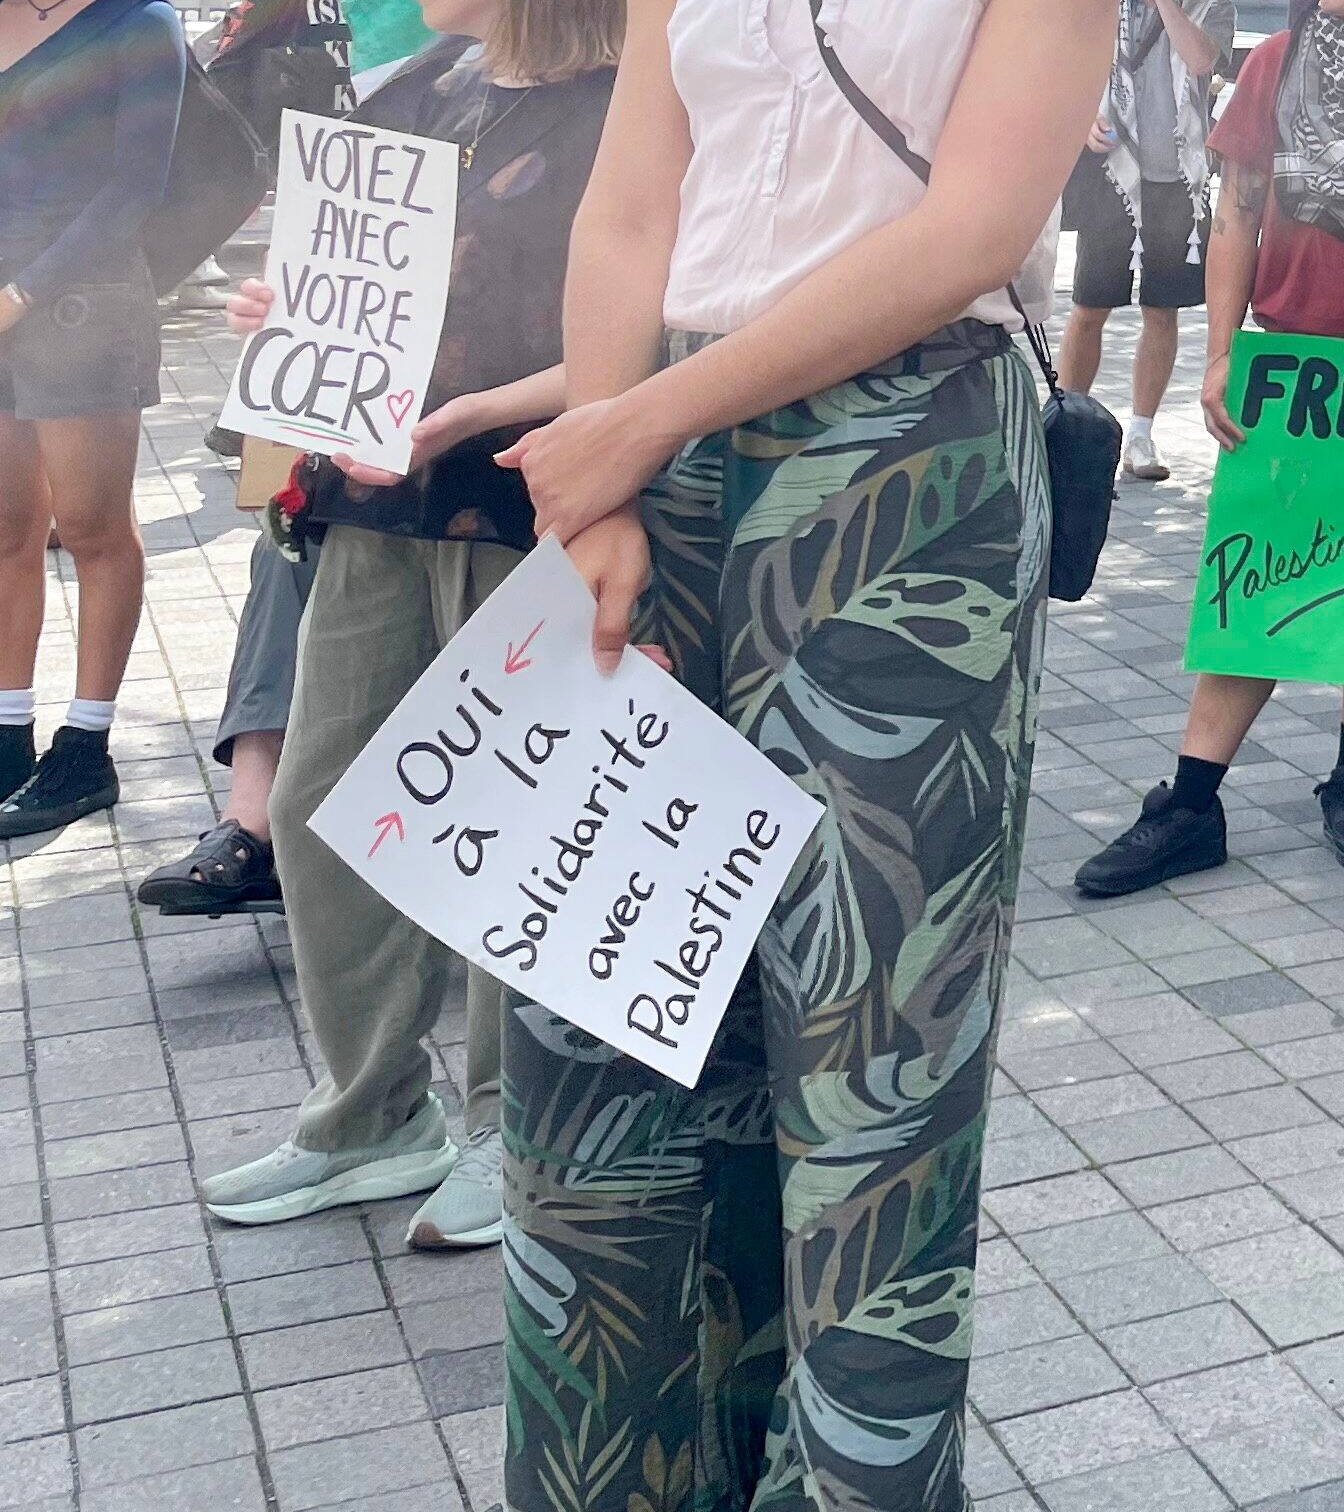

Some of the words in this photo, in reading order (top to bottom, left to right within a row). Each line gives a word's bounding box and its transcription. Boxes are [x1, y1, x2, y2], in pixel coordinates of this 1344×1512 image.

[295, 123, 433, 214] VOTEZ
[311, 199, 409, 271] AVEC
[282, 262, 413, 353] VOTRE
[433, 824, 498, 876] à
[495, 722, 570, 788] la
[482, 698, 669, 971] Solidarité
[589, 871, 655, 980] avec
[642, 798, 699, 848] la
[627, 809, 780, 1048] Palestine
